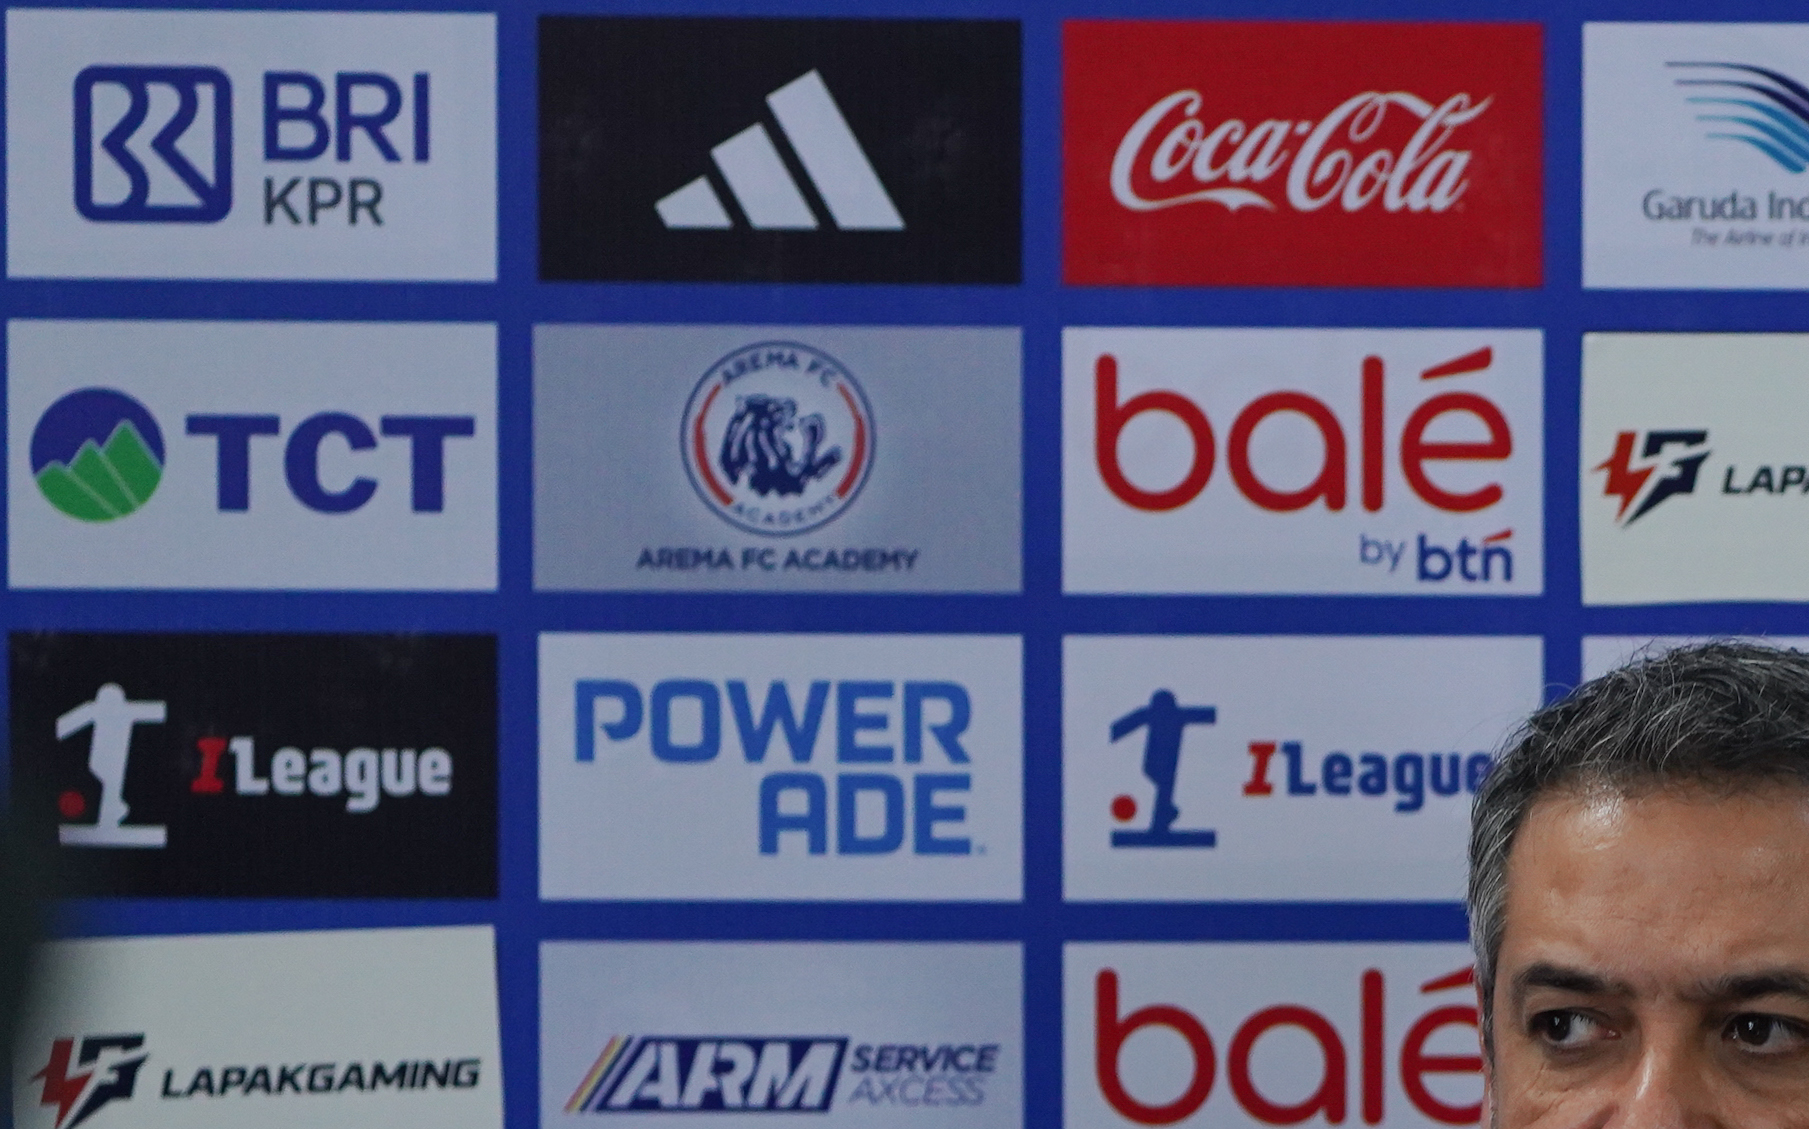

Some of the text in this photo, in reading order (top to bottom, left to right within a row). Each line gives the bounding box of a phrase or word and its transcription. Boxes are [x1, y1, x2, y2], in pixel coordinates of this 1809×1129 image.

[262, 71, 431, 163] BRI
[1109, 88, 1494, 213] Coca-Cola
[263, 177, 384, 226] KPR
[1641, 188, 1758, 223] Garuda
[1094, 346, 1514, 514] balé
[184, 410, 476, 516] TCT
[635, 547, 920, 573] AREMA FC ACADEMY
[1360, 534, 1404, 572] by
[574, 679, 972, 764] POWER
[758, 771, 973, 856] ADE
[160, 1059, 481, 1100] LAPAKGAMING
[606, 1042, 840, 1109] ARM
[850, 1043, 1000, 1075] SERVICE
[848, 1077, 987, 1109] AXCESS
